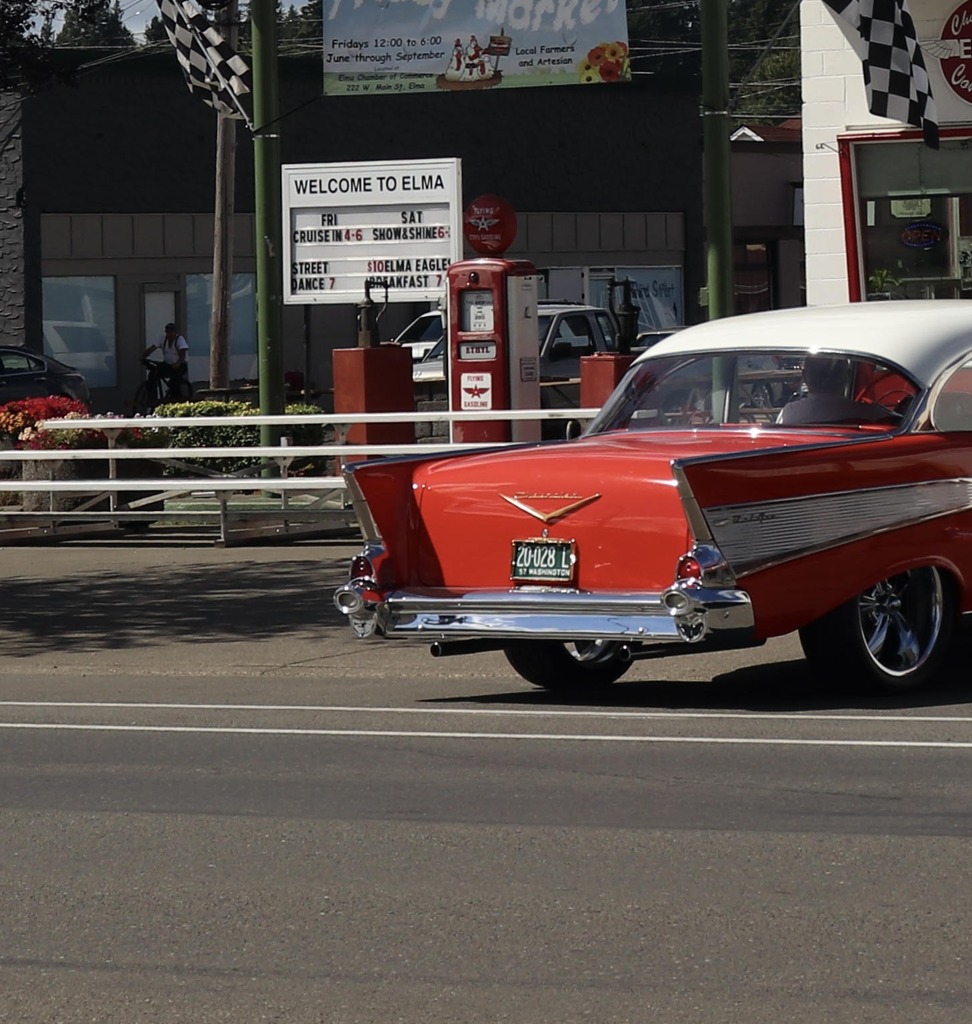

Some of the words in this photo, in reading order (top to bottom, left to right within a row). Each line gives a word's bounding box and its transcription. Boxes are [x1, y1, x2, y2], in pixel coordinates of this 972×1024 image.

[331, 39, 369, 51] Fridays
[374, 38, 403, 48] 12:00
[407, 38, 416, 47] to
[420, 36, 442, 46] 6:00
[515, 46, 537, 55] Local
[540, 45, 575, 54] Farmers
[326, 53, 350, 63] June
[355, 52, 392, 64] through
[395, 50, 445, 63] September
[518, 58, 533, 67] and
[537, 57, 573, 66] Artesian
[357, 73, 388, 81] Chamber
[400, 72, 434, 80] Commerce
[346, 84, 360, 92] 222
[375, 83, 392, 91] Main
[408, 82, 425, 90] Elma
[294, 176, 373, 194] WELCOME
[377, 176, 397, 192] TO
[402, 175, 445, 191] ELMA
[321, 213, 338, 226] FRI
[401, 211, 423, 224] SAT
[293, 228, 330, 243] CRUISE
[332, 228, 342, 242] IN
[344, 228, 363, 241] 4-6
[901, 229, 942, 242] OPEN
[292, 262, 329, 275] STREET
[384, 259, 412, 273] ELMA
[291, 278, 325, 291] DANCE
[329, 277, 336, 290] 7
[465, 345, 490, 354] ETHYL
[464, 400, 488, 408] GASOLINE
[516, 546, 556, 568] 20-028
[561, 547, 569, 568] L
[528, 568, 570, 576] WASHINGTON
